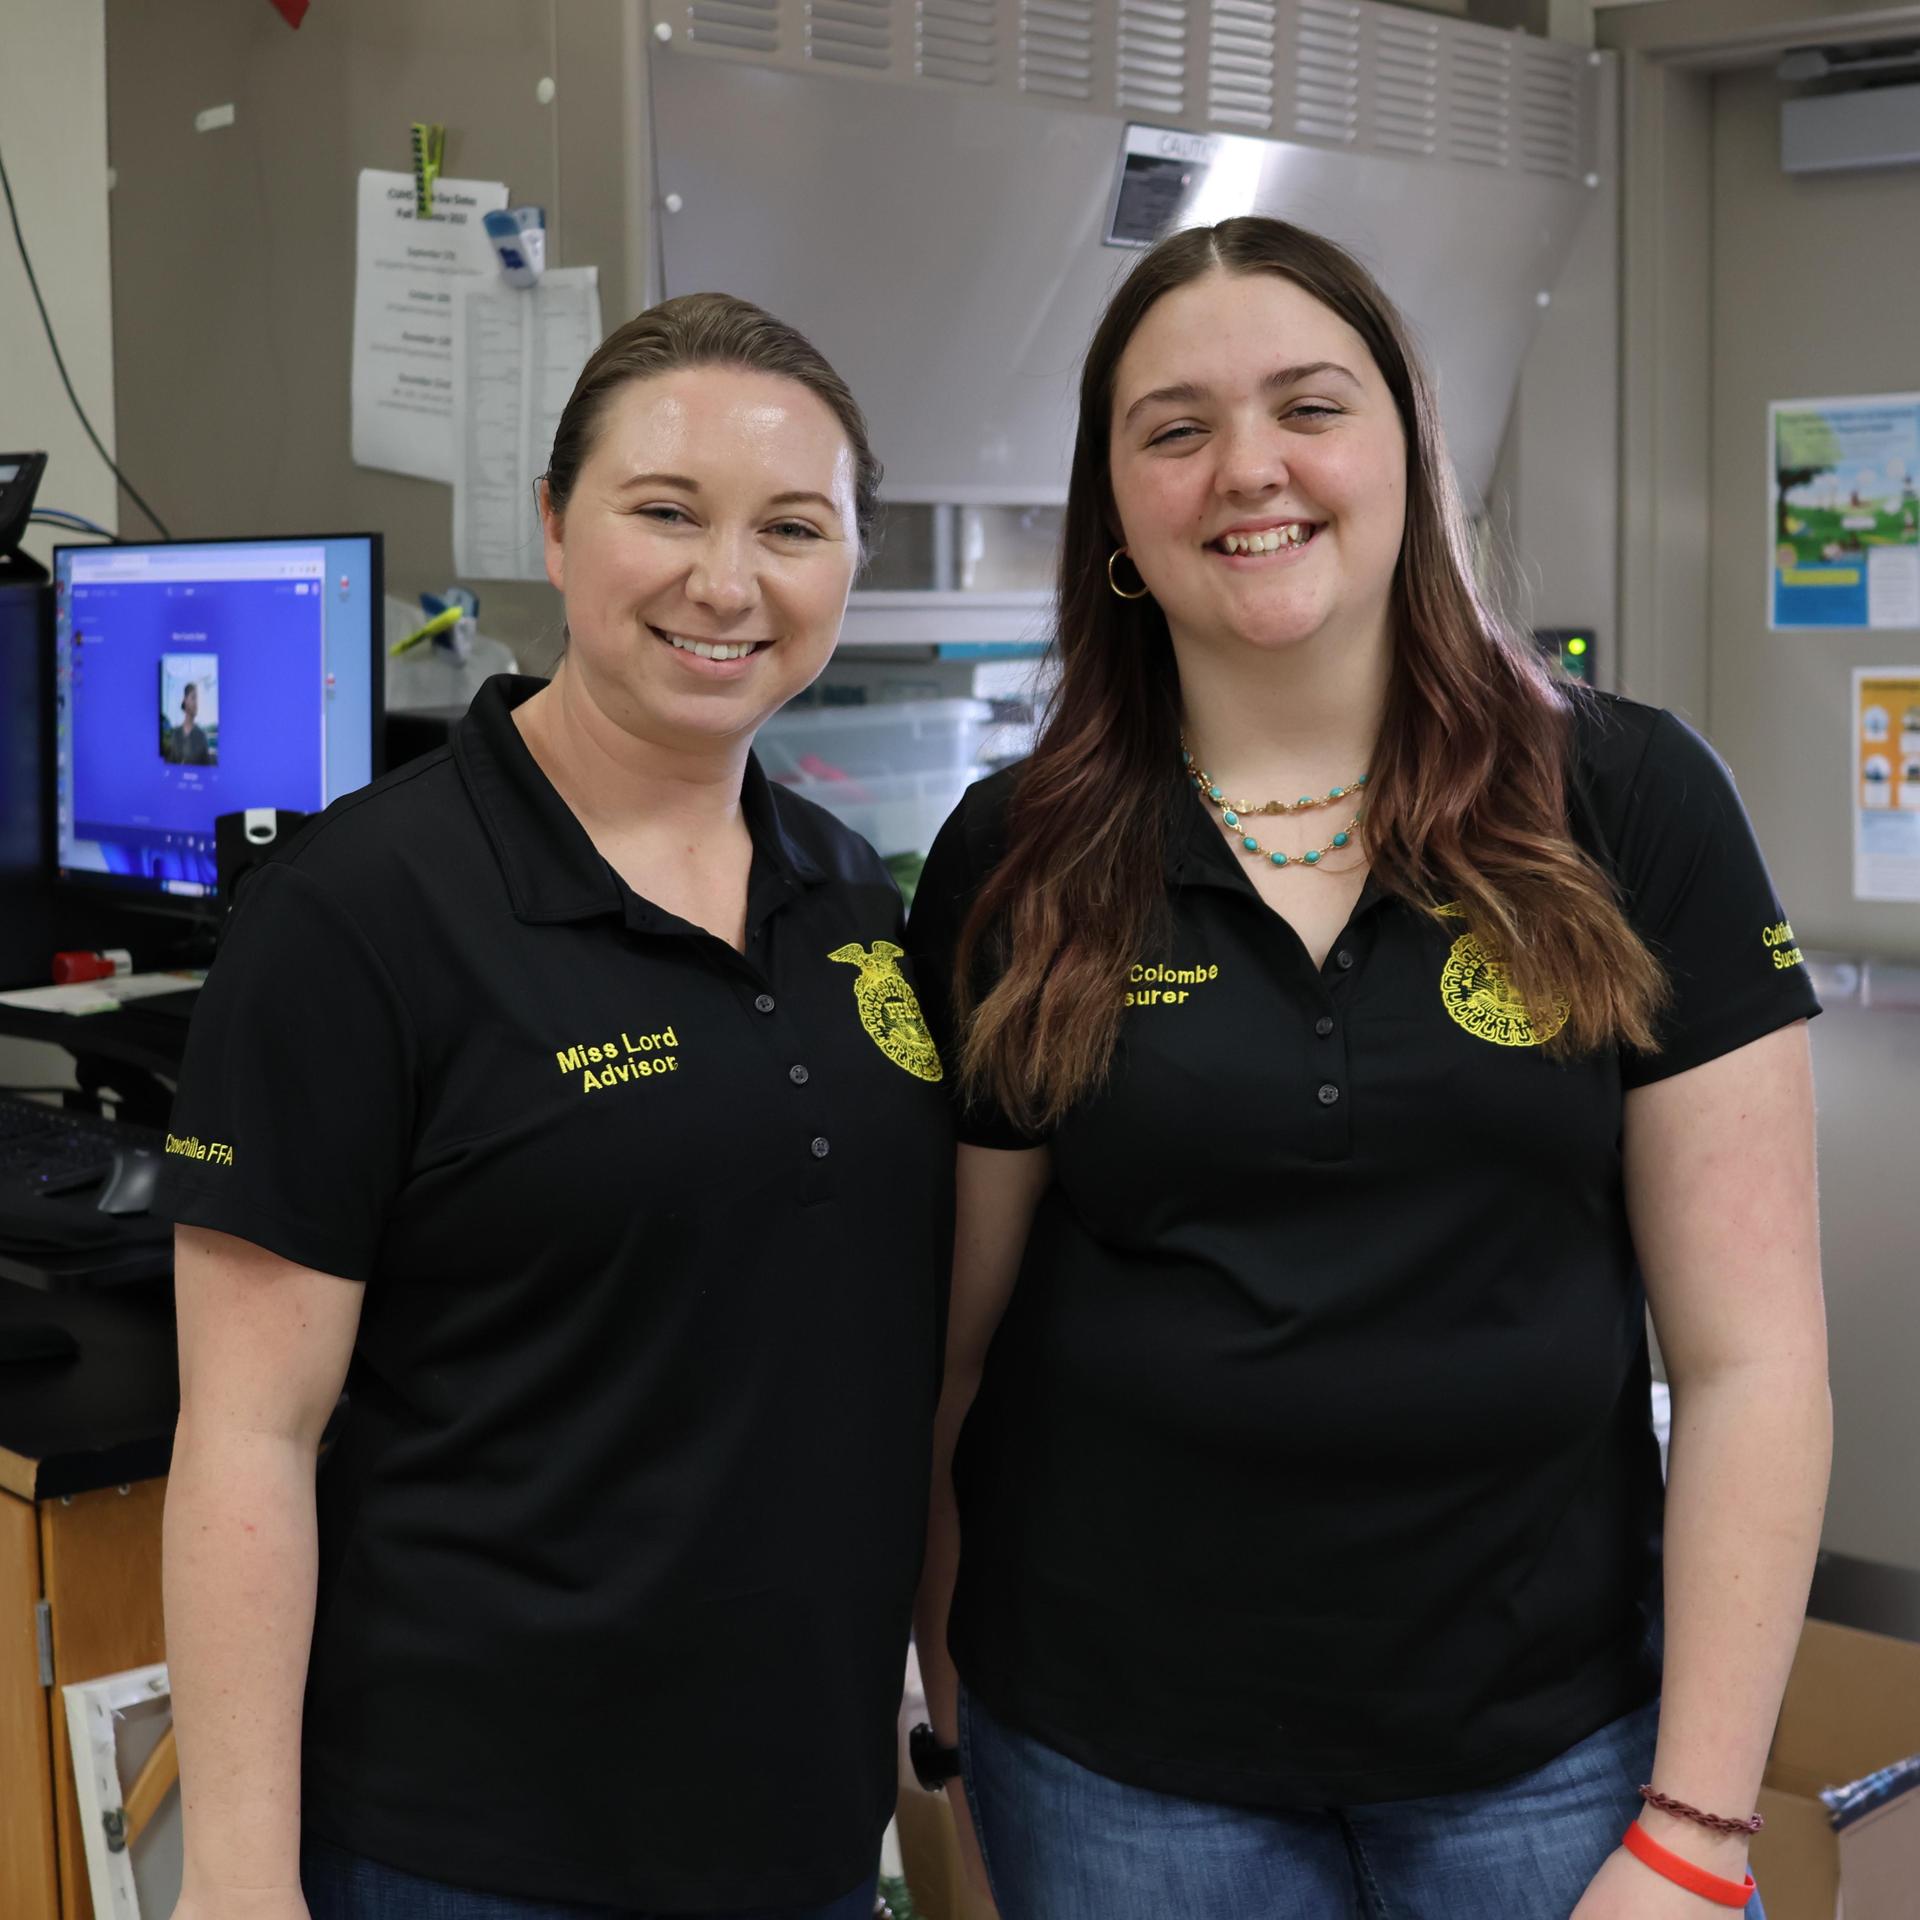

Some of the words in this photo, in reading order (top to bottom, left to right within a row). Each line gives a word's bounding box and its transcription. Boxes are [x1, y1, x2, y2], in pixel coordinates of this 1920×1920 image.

[1130, 963, 1219, 984] Colombe
[1124, 989, 1190, 1007] surer
[556, 1044, 619, 1074] Miss
[621, 1026, 679, 1053] Lord
[584, 1056, 677, 1093] Advisor
[206, 1142, 233, 1166] FFA
